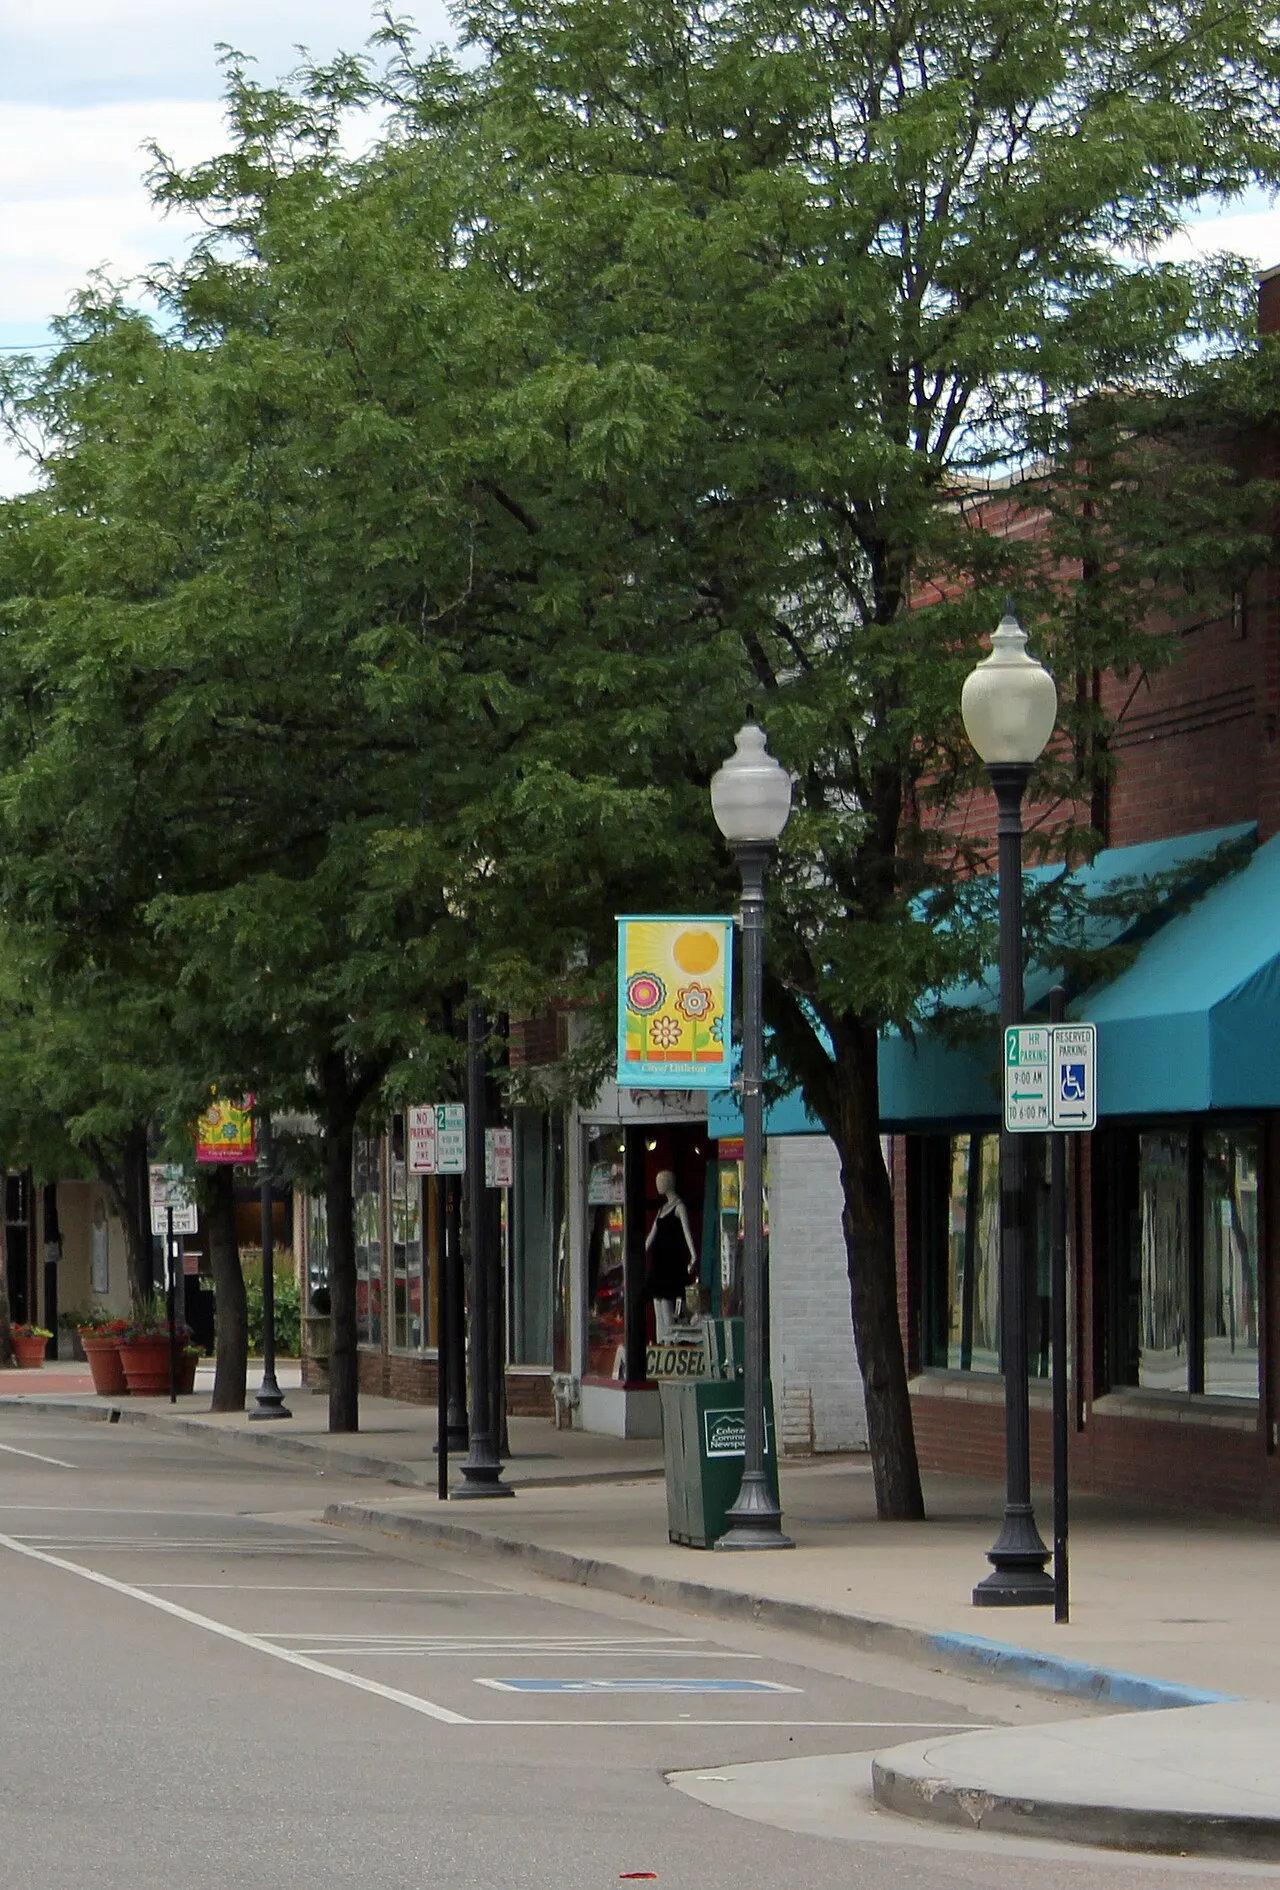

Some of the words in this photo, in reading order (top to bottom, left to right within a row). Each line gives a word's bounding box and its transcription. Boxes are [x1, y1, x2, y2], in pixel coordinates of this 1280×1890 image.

[1055, 1031, 1091, 1044] RESERVED
[1009, 1036, 1017, 1061] 2
[1028, 1032, 1040, 1045] HR
[1059, 1045, 1088, 1057] PARKING
[1020, 1049, 1048, 1062] PARKING
[642, 1063, 657, 1075] City
[669, 1063, 707, 1074] Littleton
[1014, 1071, 1031, 1085] 9:00
[1032, 1071, 1042, 1084] AM
[416, 1112, 428, 1125] NO
[1009, 1106, 1017, 1120] TO
[1019, 1106, 1036, 1119] 6:00
[1038, 1105, 1047, 1119] PM
[438, 1111, 445, 1128] 2
[410, 1128, 435, 1138] PARKING
[157, 1220, 191, 1231] PRSENT
[646, 1349, 706, 1376] CLOSED
[711, 1434, 745, 1442] Commu
[716, 1427, 745, 1436] Colora
[710, 1441, 745, 1449] Newspa
